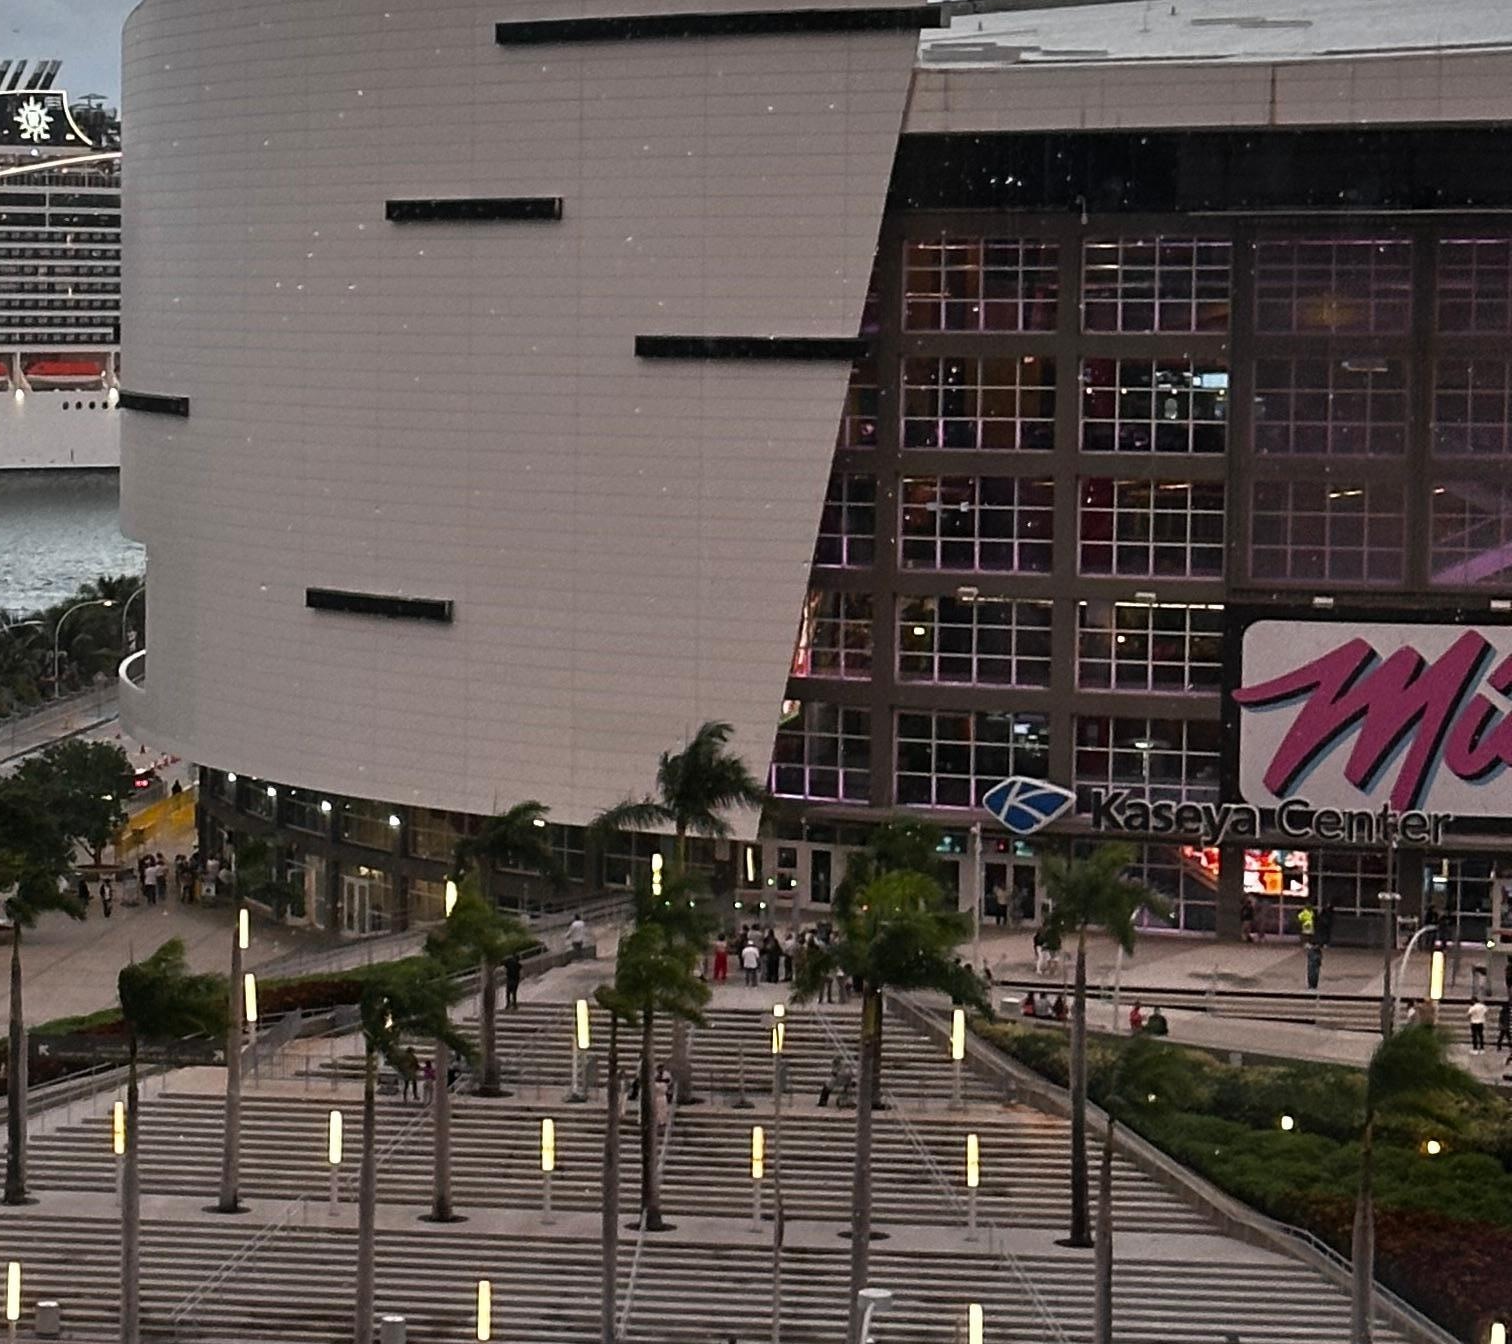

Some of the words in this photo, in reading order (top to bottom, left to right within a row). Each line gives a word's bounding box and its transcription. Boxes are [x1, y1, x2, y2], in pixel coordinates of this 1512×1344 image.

[1231, 629, 1512, 812] Mi
[1090, 787, 1261, 846] Kaseya
[1274, 796, 1454, 846] Center
